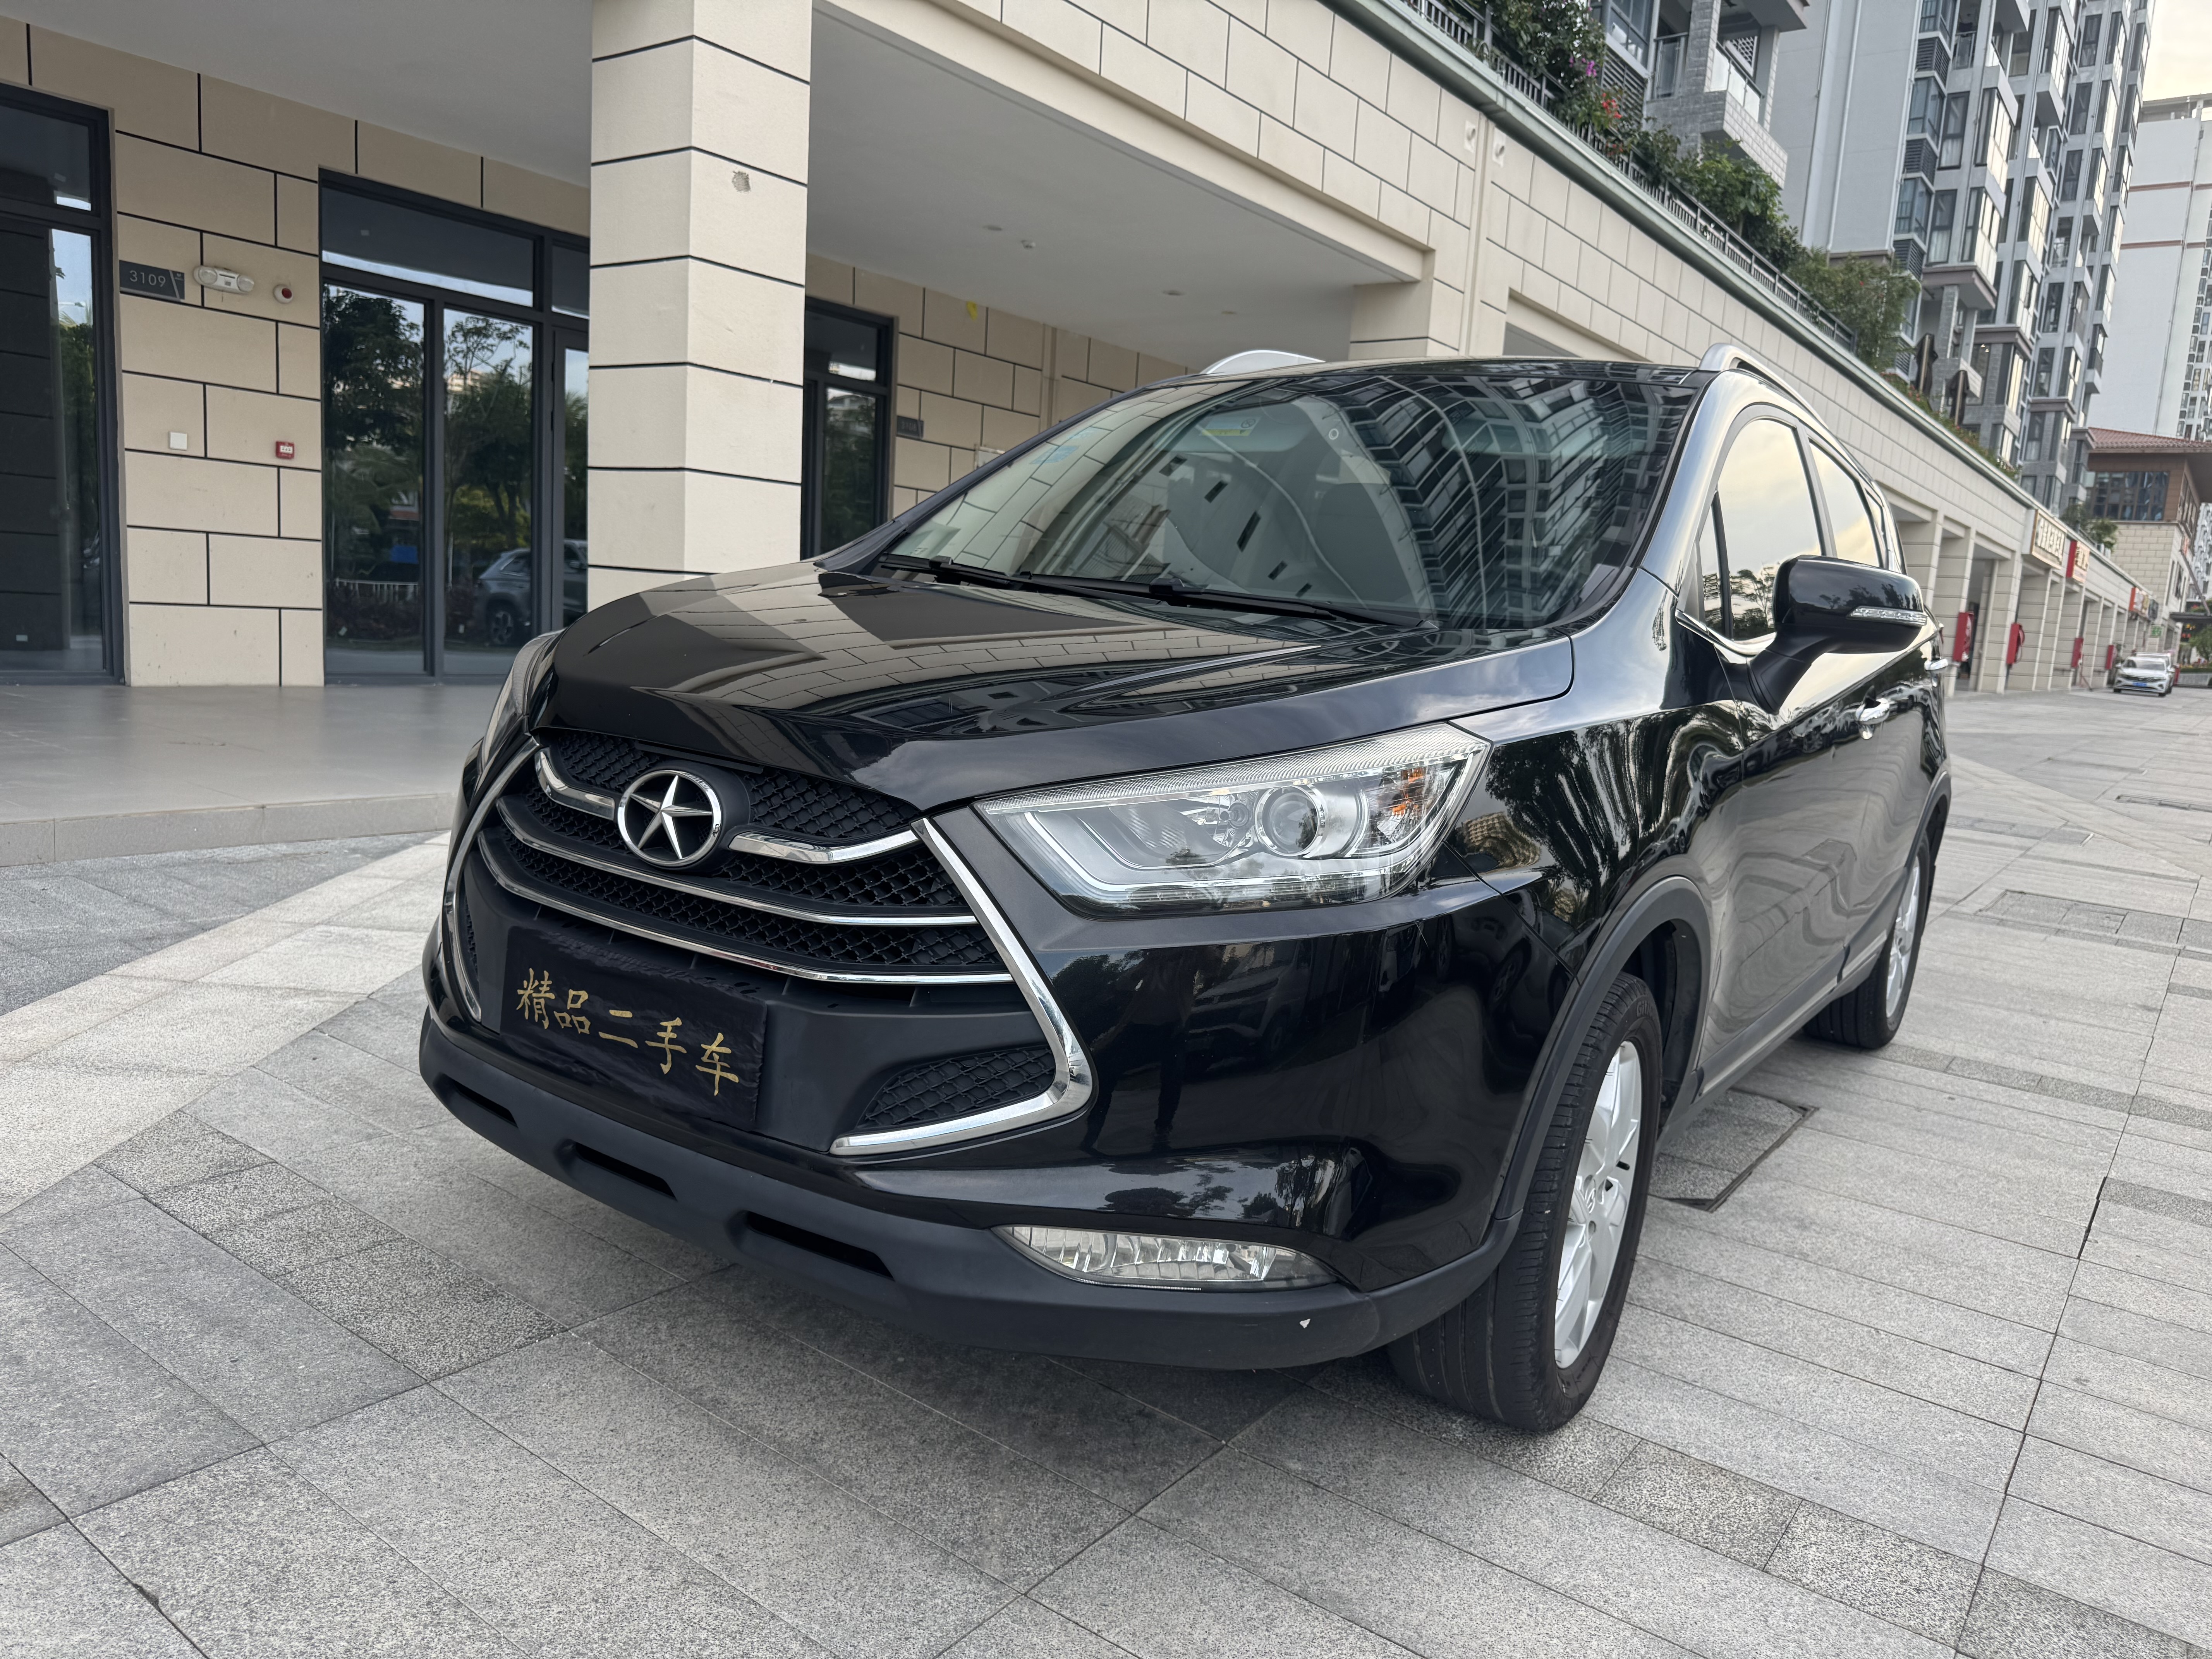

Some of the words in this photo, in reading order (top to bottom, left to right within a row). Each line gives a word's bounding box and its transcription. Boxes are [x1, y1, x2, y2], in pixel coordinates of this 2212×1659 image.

[129, 270, 166, 287] 3109
[517, 969, 739, 1096] 精品二手车
